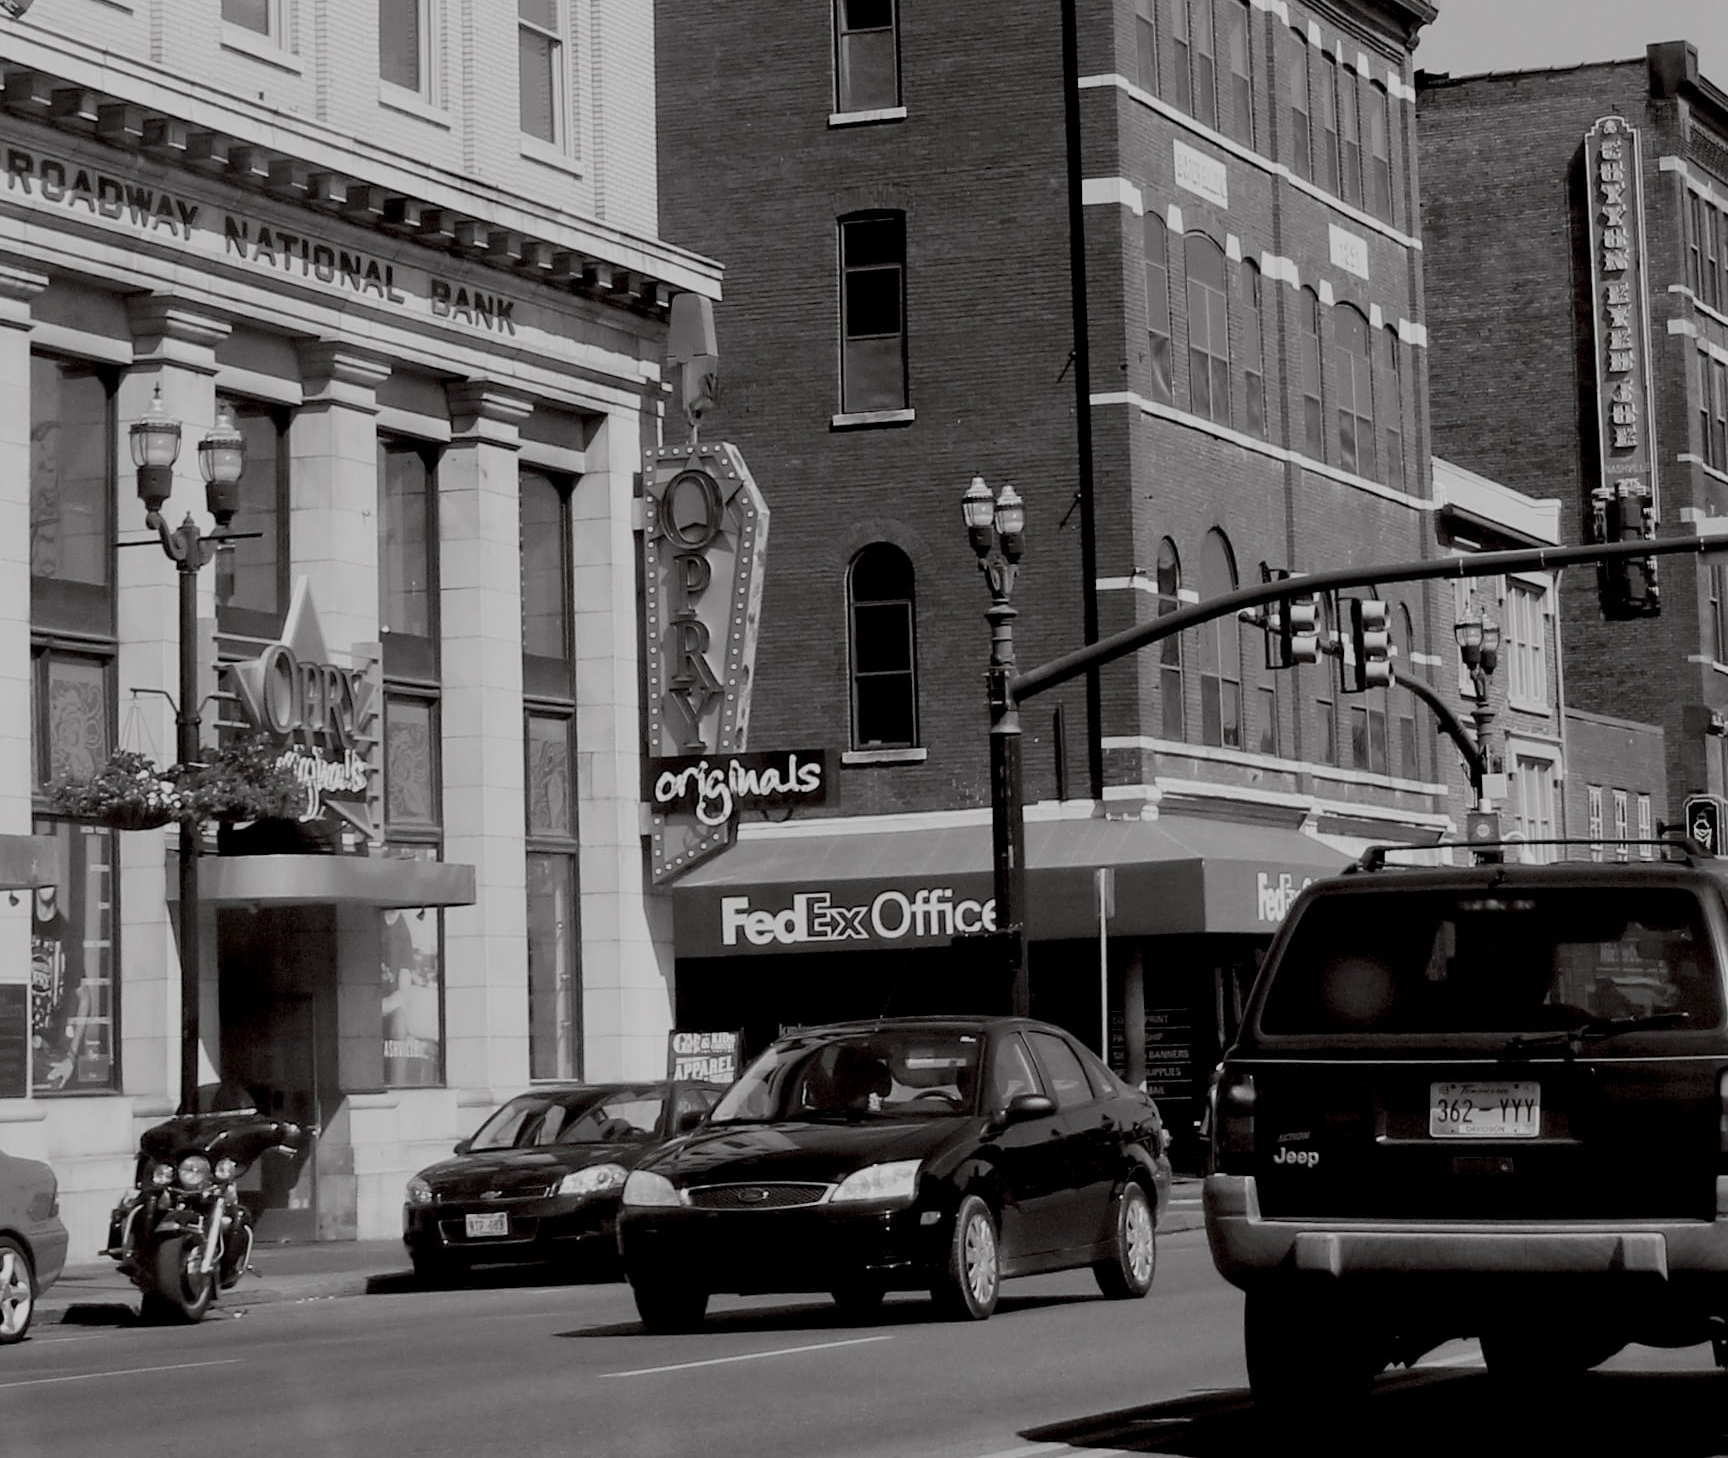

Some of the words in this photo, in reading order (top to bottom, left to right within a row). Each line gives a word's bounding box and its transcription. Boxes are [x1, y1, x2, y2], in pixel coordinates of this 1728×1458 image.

[1600, 139, 1630, 272] COTTON
[224, 215, 405, 305] NATIONAL
[431, 279, 515, 337] BANK
[1605, 282, 1635, 373] EYED
[1611, 380, 1638, 448] JOE
[658, 468, 725, 750] OPRY
[263, 645, 376, 748] OPRY
[655, 754, 822, 827] originals
[721, 892, 869, 946] FedEx
[868, 888, 997, 940] Office
[674, 1055, 735, 1082] APPAREL
[1145, 1067, 1182, 1077] UPPLIES
[1272, 1146, 1320, 1168] Jeep
